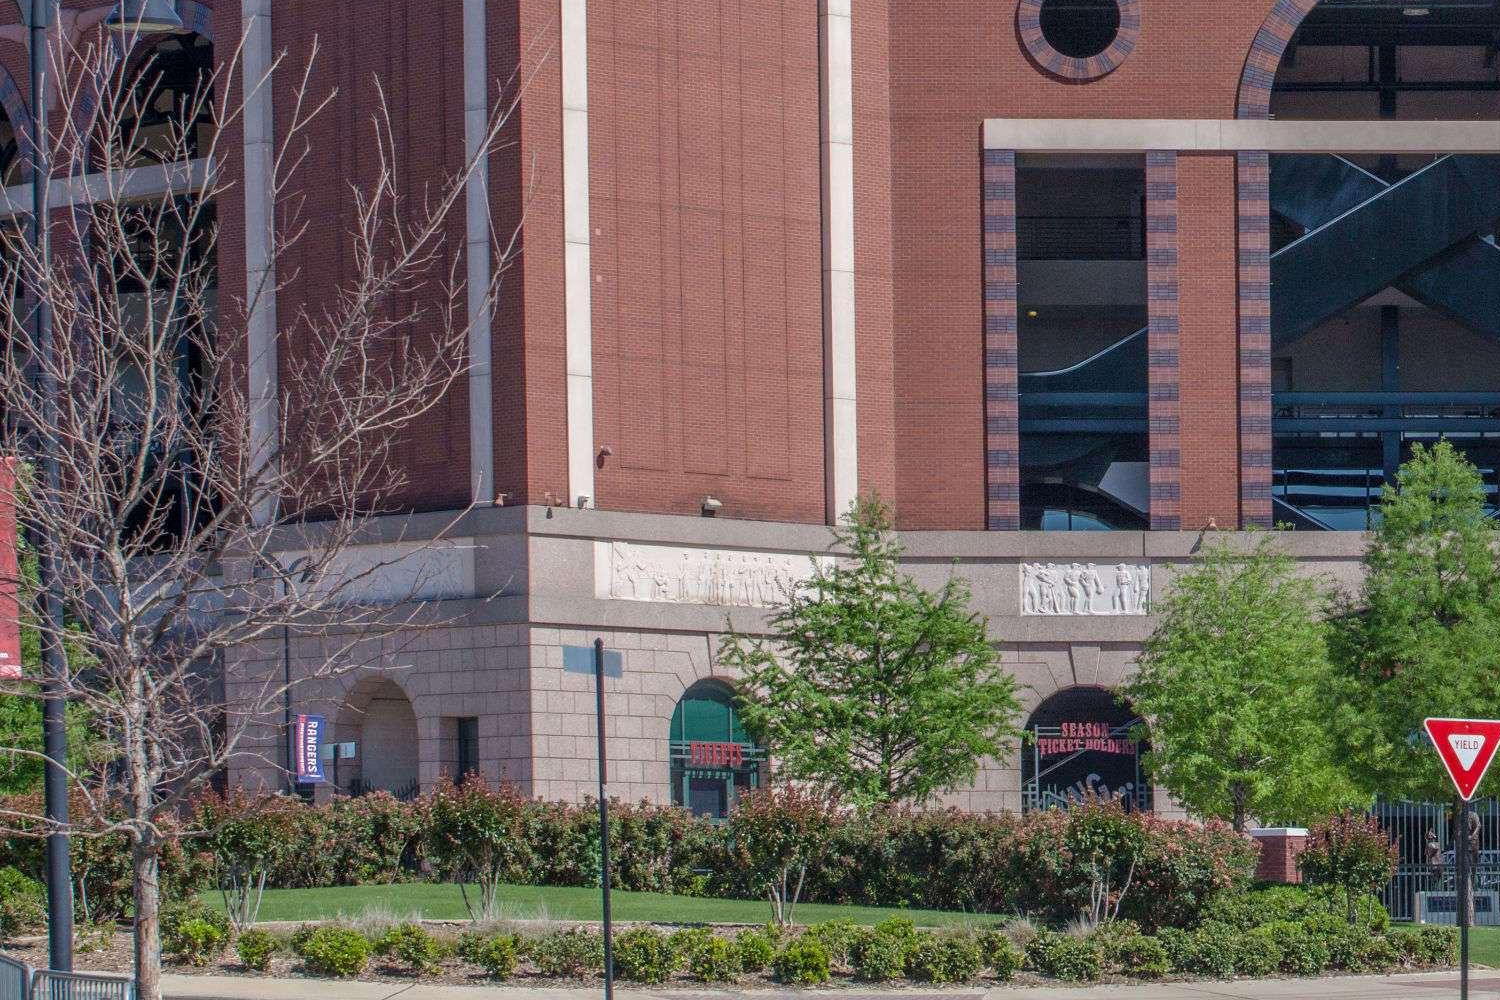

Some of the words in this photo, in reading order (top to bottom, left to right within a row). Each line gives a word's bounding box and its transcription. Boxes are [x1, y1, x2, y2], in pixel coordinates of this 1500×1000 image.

[1060, 722, 1110, 738] SEASON
[307, 721, 319, 775] RANGERS
[1038, 738, 1081, 755] TICKET
[1454, 739, 1479, 750] YIELD
